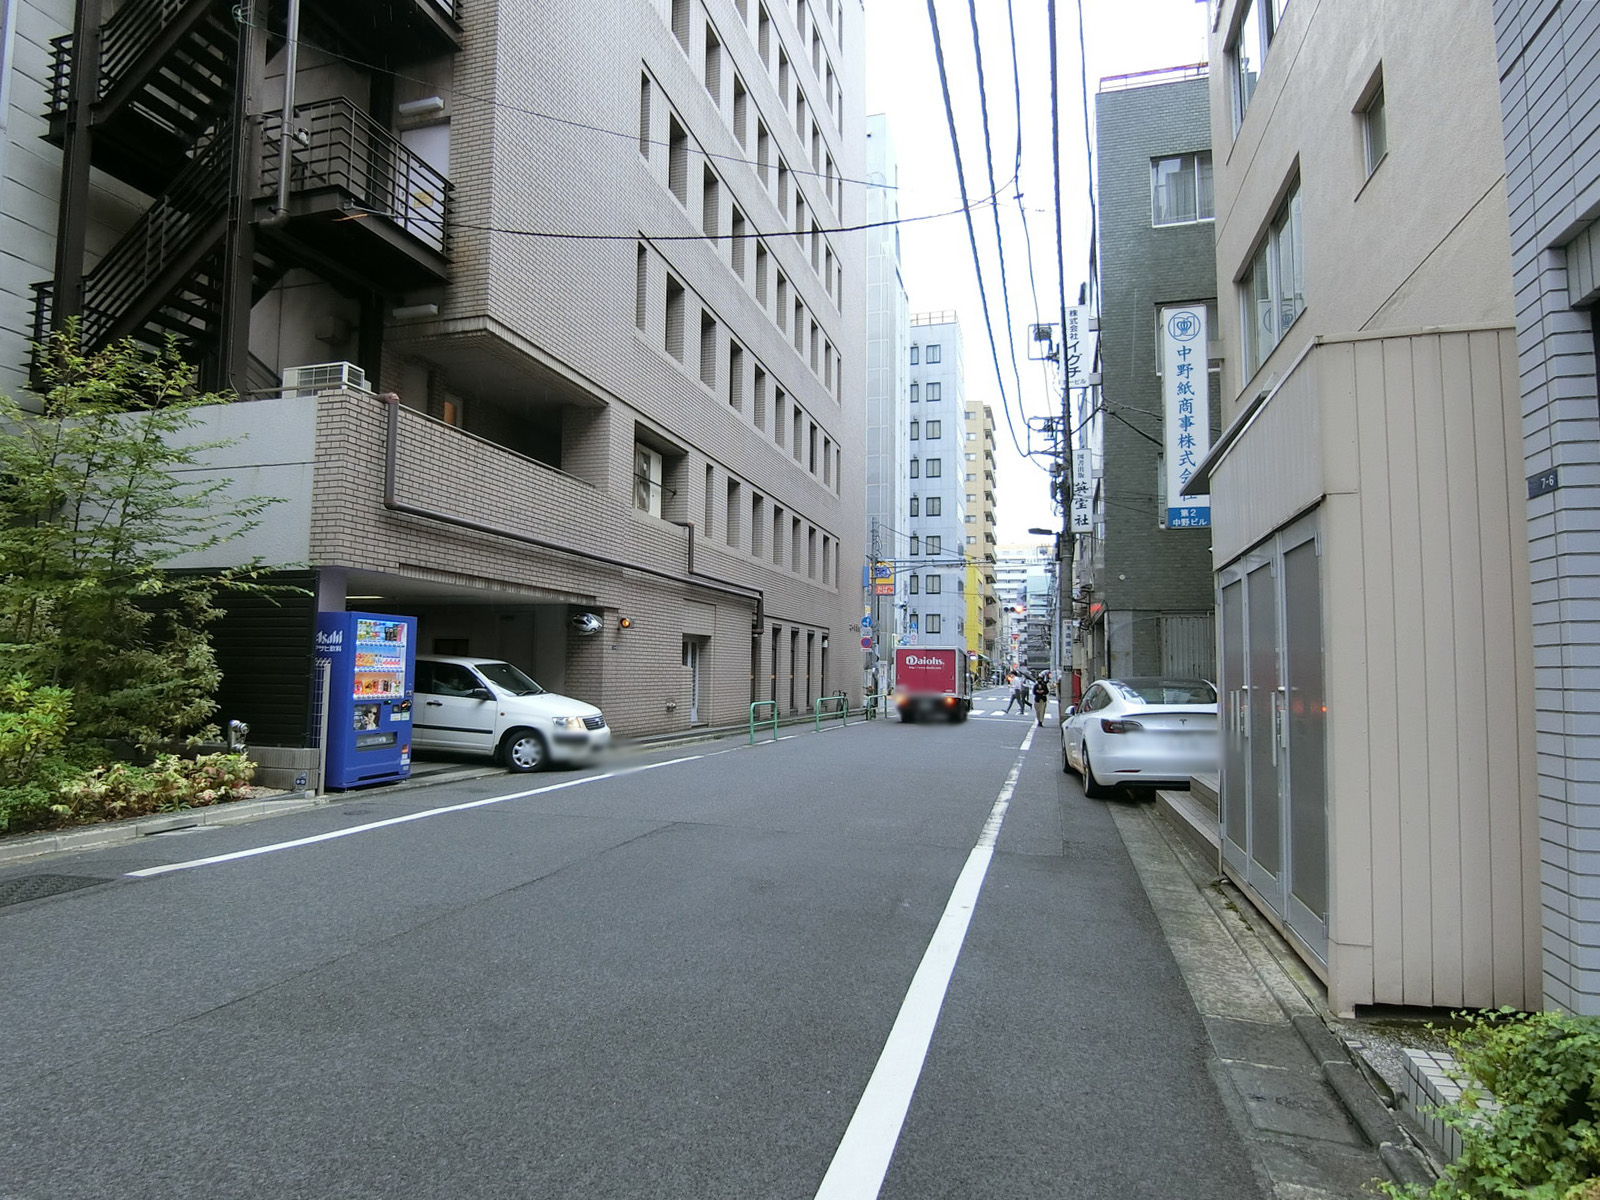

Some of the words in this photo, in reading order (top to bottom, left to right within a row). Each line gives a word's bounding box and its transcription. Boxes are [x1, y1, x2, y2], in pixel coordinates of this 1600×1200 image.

[1176, 345, 1197, 502] 中野紙商事株式会
[1541, 475, 1554, 489] 7-6
[1180, 508, 1197, 518] 第2
[1172, 518, 1208, 528] 中野ビル
